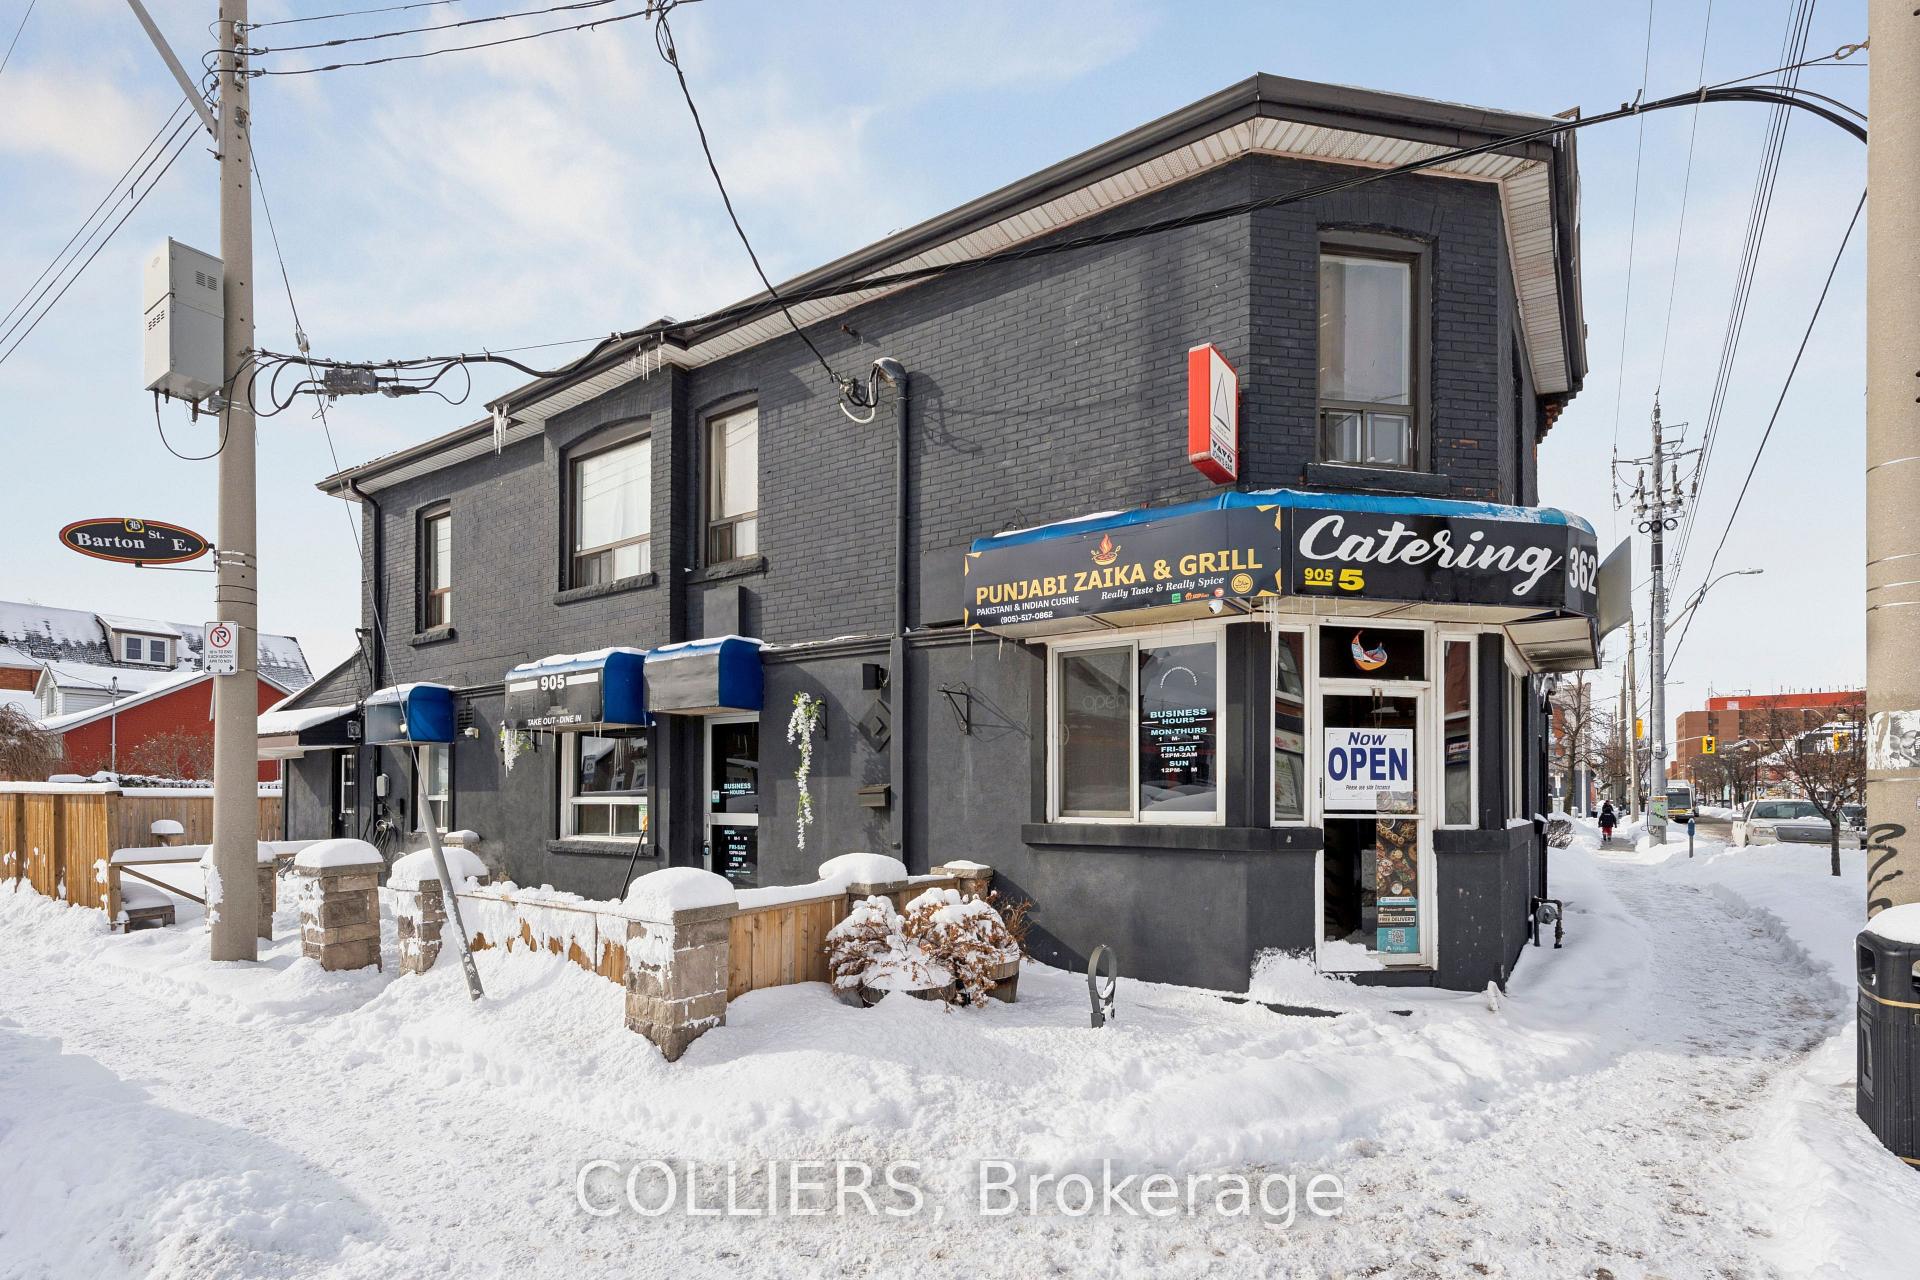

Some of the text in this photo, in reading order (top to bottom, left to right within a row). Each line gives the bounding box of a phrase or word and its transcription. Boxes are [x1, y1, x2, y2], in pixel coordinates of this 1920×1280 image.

[76, 532, 146, 549] Barton
[148, 530, 165, 540] St.
[172, 538, 192, 551] E.
[1299, 514, 1562, 596] Catering
[976, 548, 1263, 605] PUNJABI ZAIKA & GRILL
[1304, 568, 1365, 591] 905 5
[1569, 547, 1597, 595] 362
[1101, 577, 1225, 600] Really Taste & Really Spice
[976, 596, 1079, 616] PAKISTANI & INDIAN CUSINE
[540, 674, 565, 691] 905
[543, 717, 556, 725] OUT
[560, 715, 574, 723] DINE
[575, 714, 582, 722] IN
[1150, 708, 1208, 718] BUSINESS
[1150, 727, 1208, 735] MON-THURS
[1328, 747, 1408, 781] OPEN
